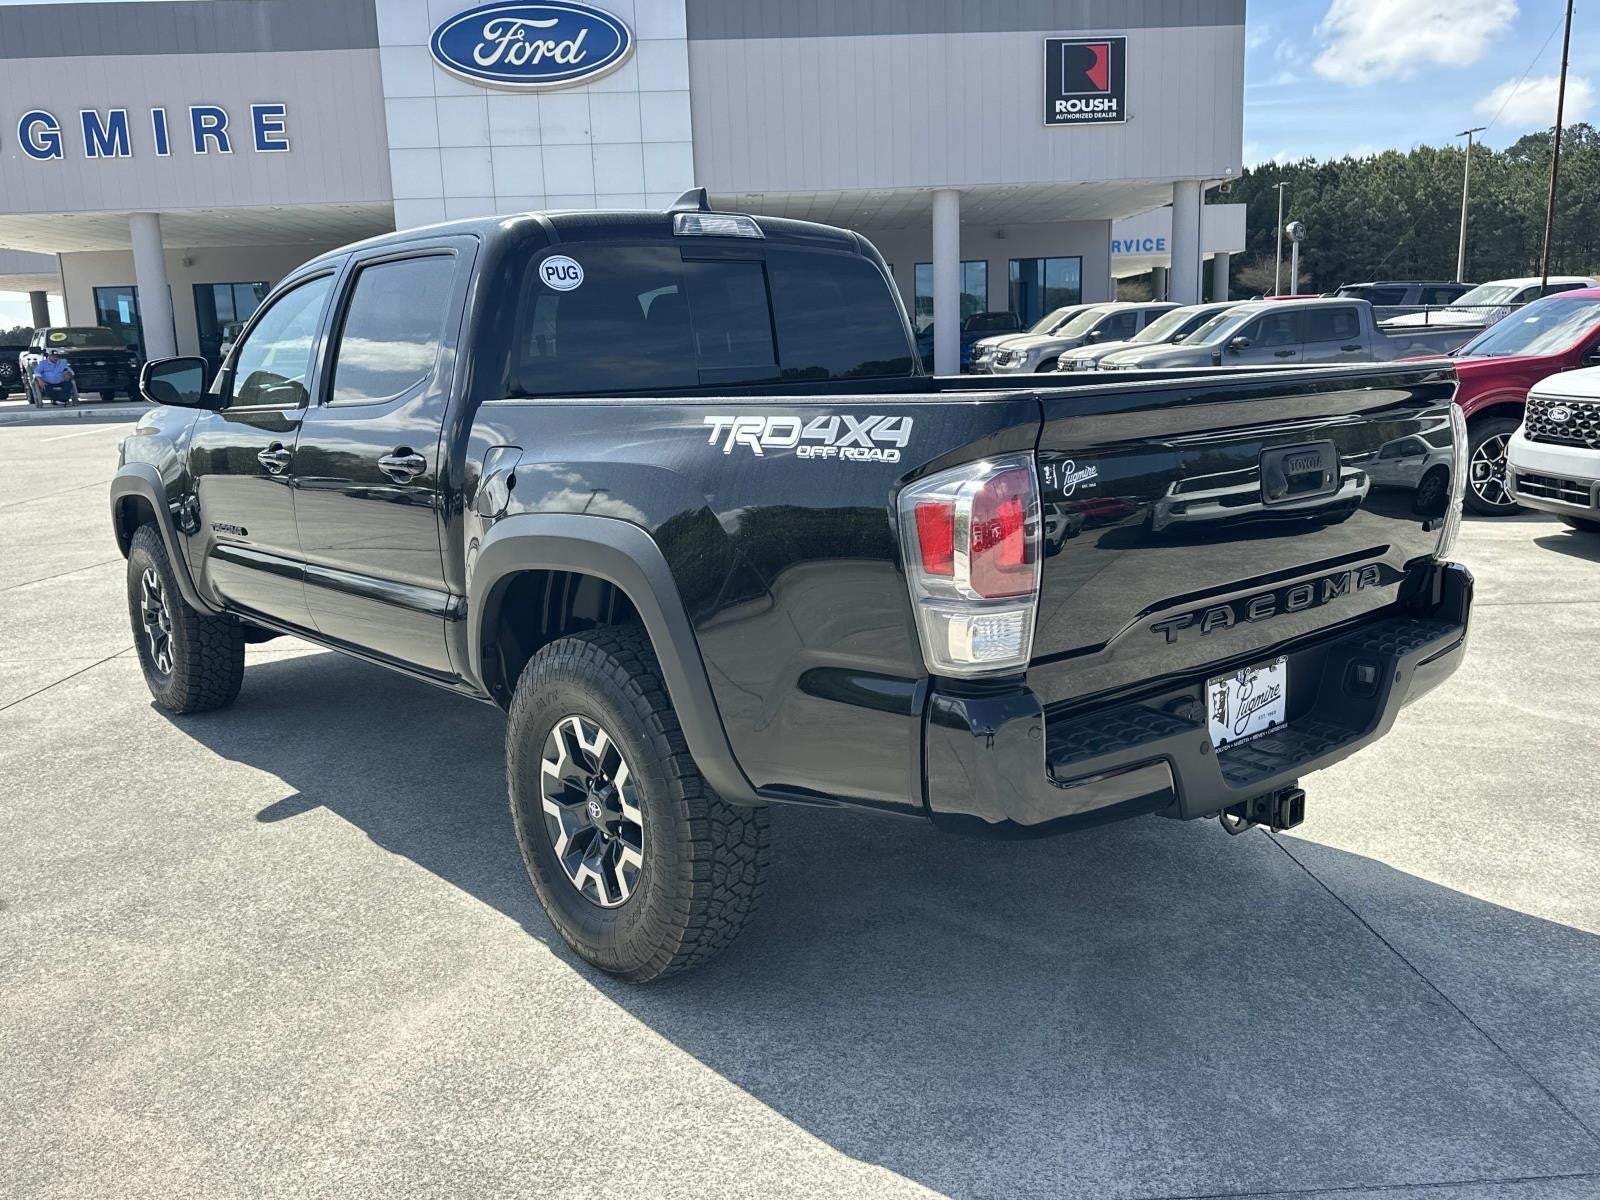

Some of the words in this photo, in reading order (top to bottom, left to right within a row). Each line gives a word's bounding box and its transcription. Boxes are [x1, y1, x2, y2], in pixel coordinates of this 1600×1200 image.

[473, 17, 588, 67] Ford
[1055, 98, 1117, 113] ROUSH
[1094, 111, 1117, 119] DEALER
[17, 103, 290, 160] GMIRE
[1112, 238, 1166, 253] RVICE
[545, 265, 579, 281] PUG
[703, 415, 802, 457] TRD
[796, 445, 838, 460] OFF
[838, 447, 900, 463] ROAD
[1150, 564, 1383, 645] TACOMA
[1233, 679, 1281, 737] Pugmire
